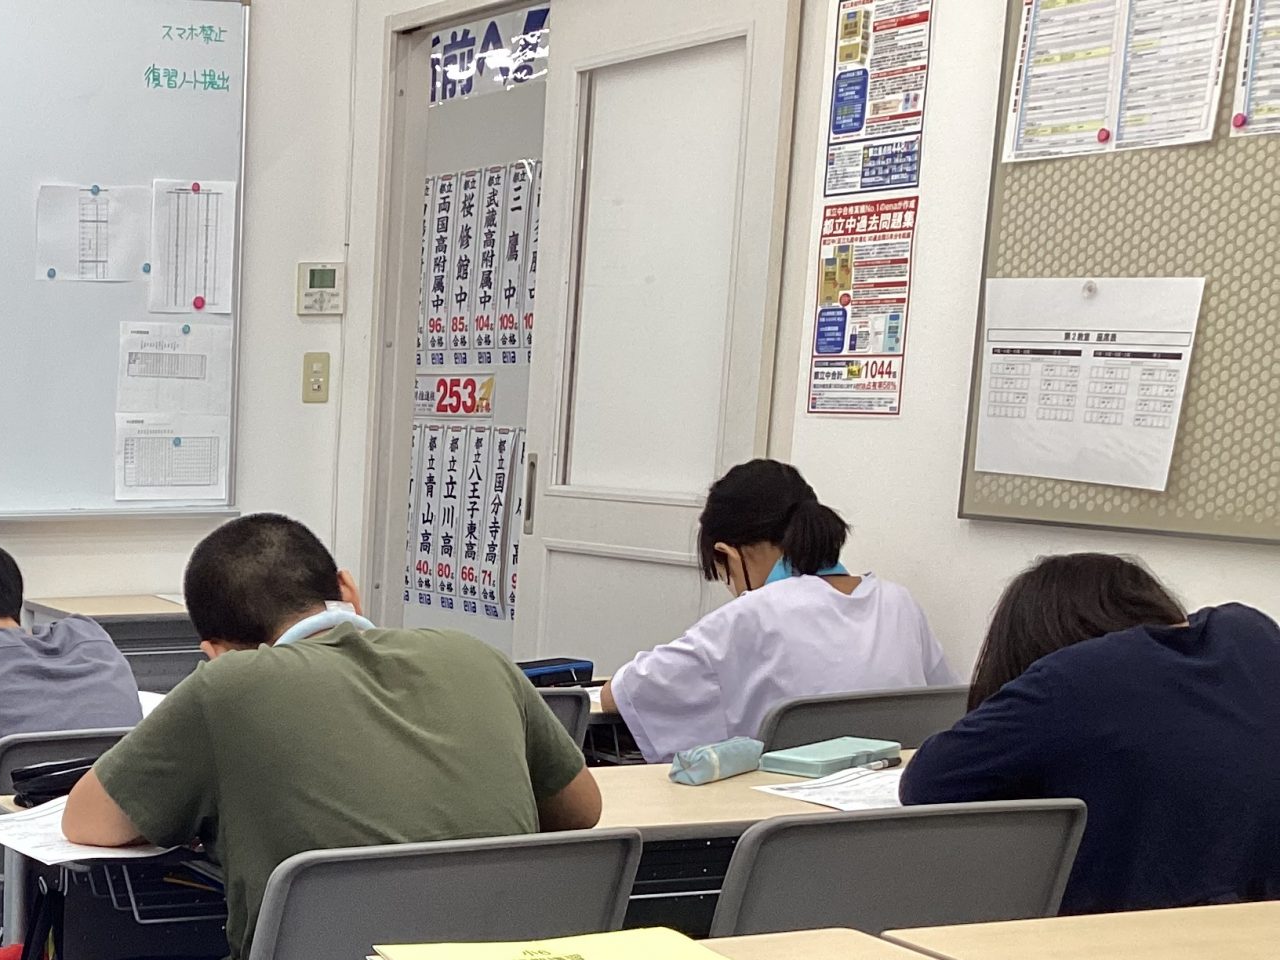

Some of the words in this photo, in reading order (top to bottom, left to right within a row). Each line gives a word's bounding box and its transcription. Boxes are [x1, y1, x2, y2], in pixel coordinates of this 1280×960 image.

[161, 24, 228, 45] スマホ禁止
[144, 63, 230, 92] 復習ノート提出
[822, 211, 915, 236] 都立中過去問題集
[436, 378, 477, 414] 253
